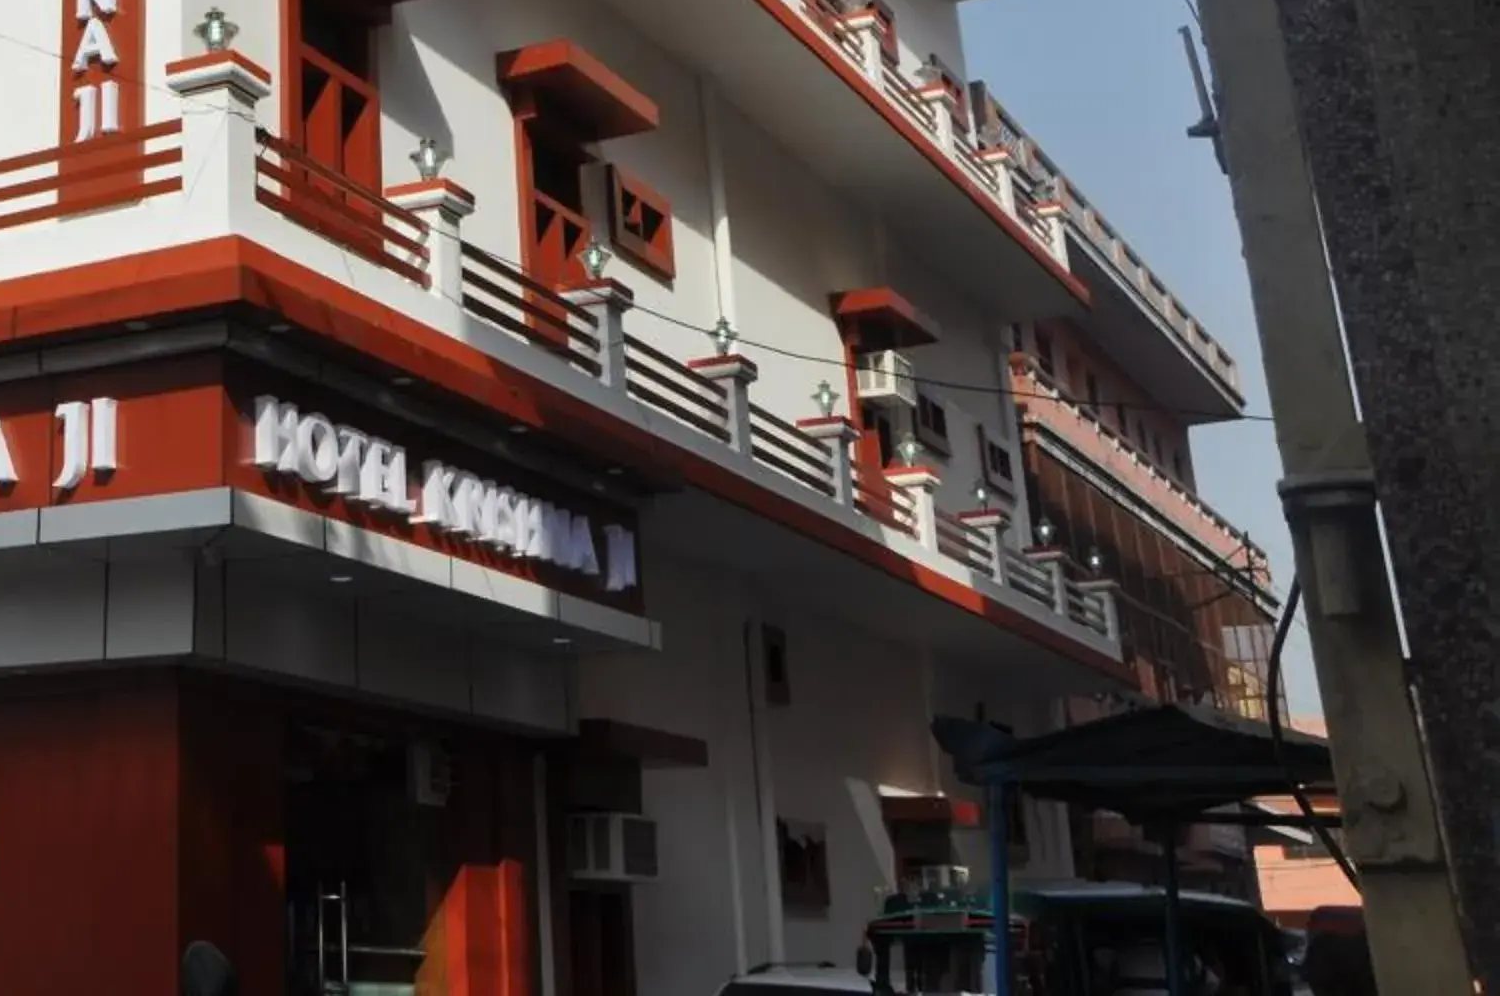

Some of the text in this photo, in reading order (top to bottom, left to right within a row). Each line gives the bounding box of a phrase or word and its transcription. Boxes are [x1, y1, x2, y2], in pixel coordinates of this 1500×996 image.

[74, 81, 119, 143] JI
[55, 397, 117, 488] JI
[254, 395, 417, 513] HOTEL
[422, 460, 599, 575] KRISHNA
